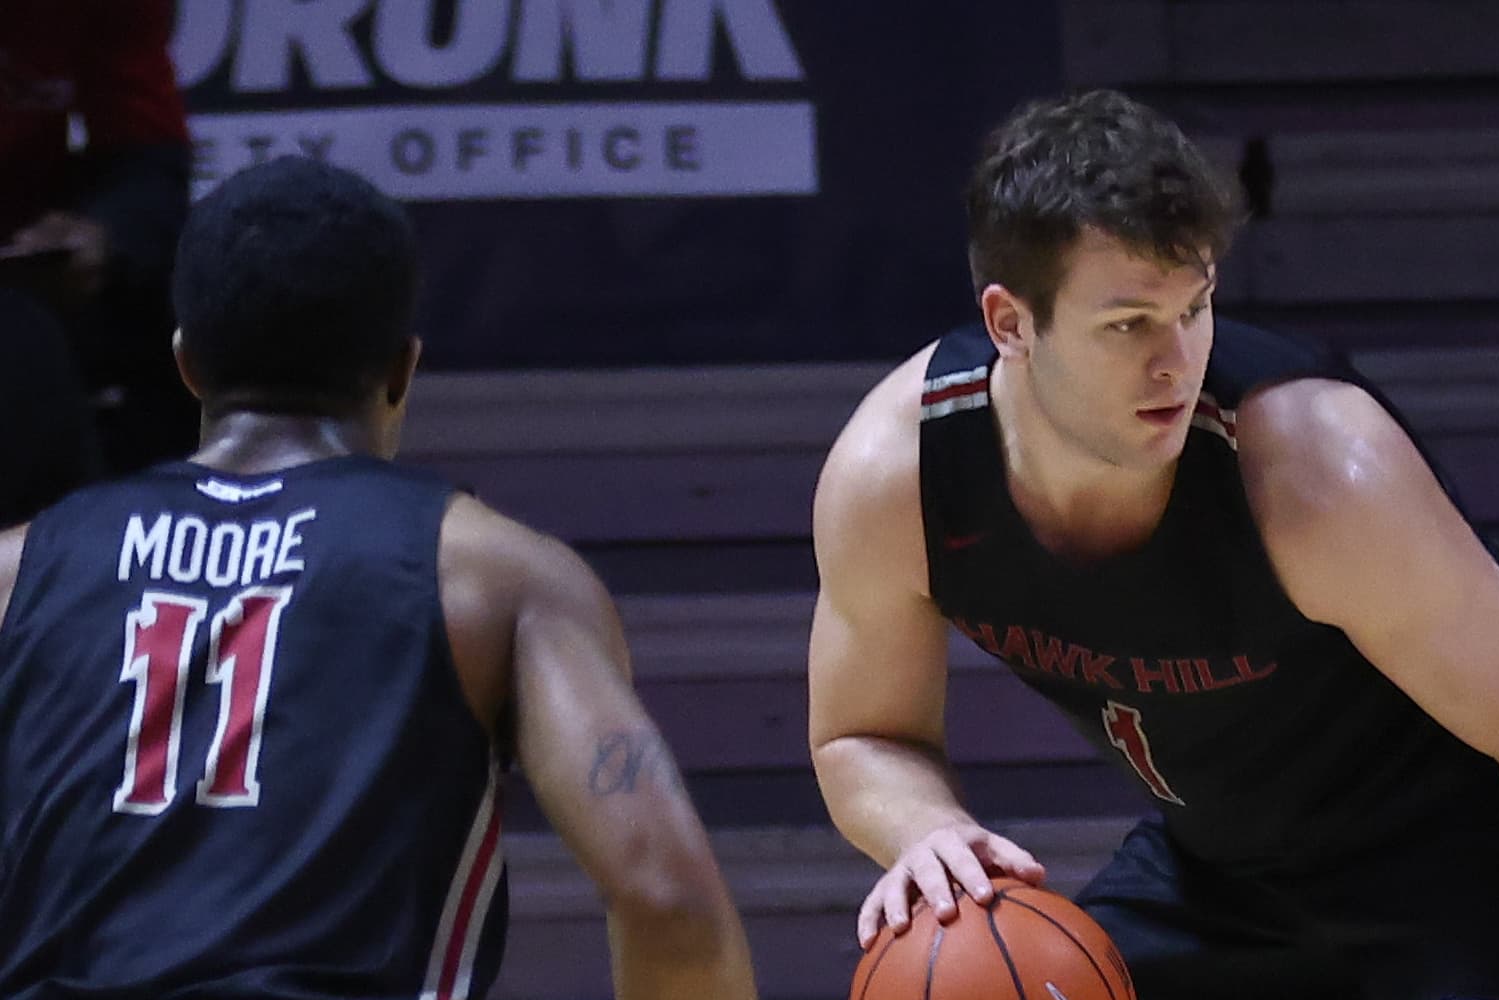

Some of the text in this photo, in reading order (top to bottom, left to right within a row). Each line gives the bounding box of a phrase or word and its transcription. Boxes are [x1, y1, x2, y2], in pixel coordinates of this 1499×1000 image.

[391, 125, 701, 175] OFFICE
[118, 509, 316, 587] MOORE
[113, 586, 293, 816] 11
[1129, 655, 1278, 694] HILL
[1102, 700, 1186, 806] 1
